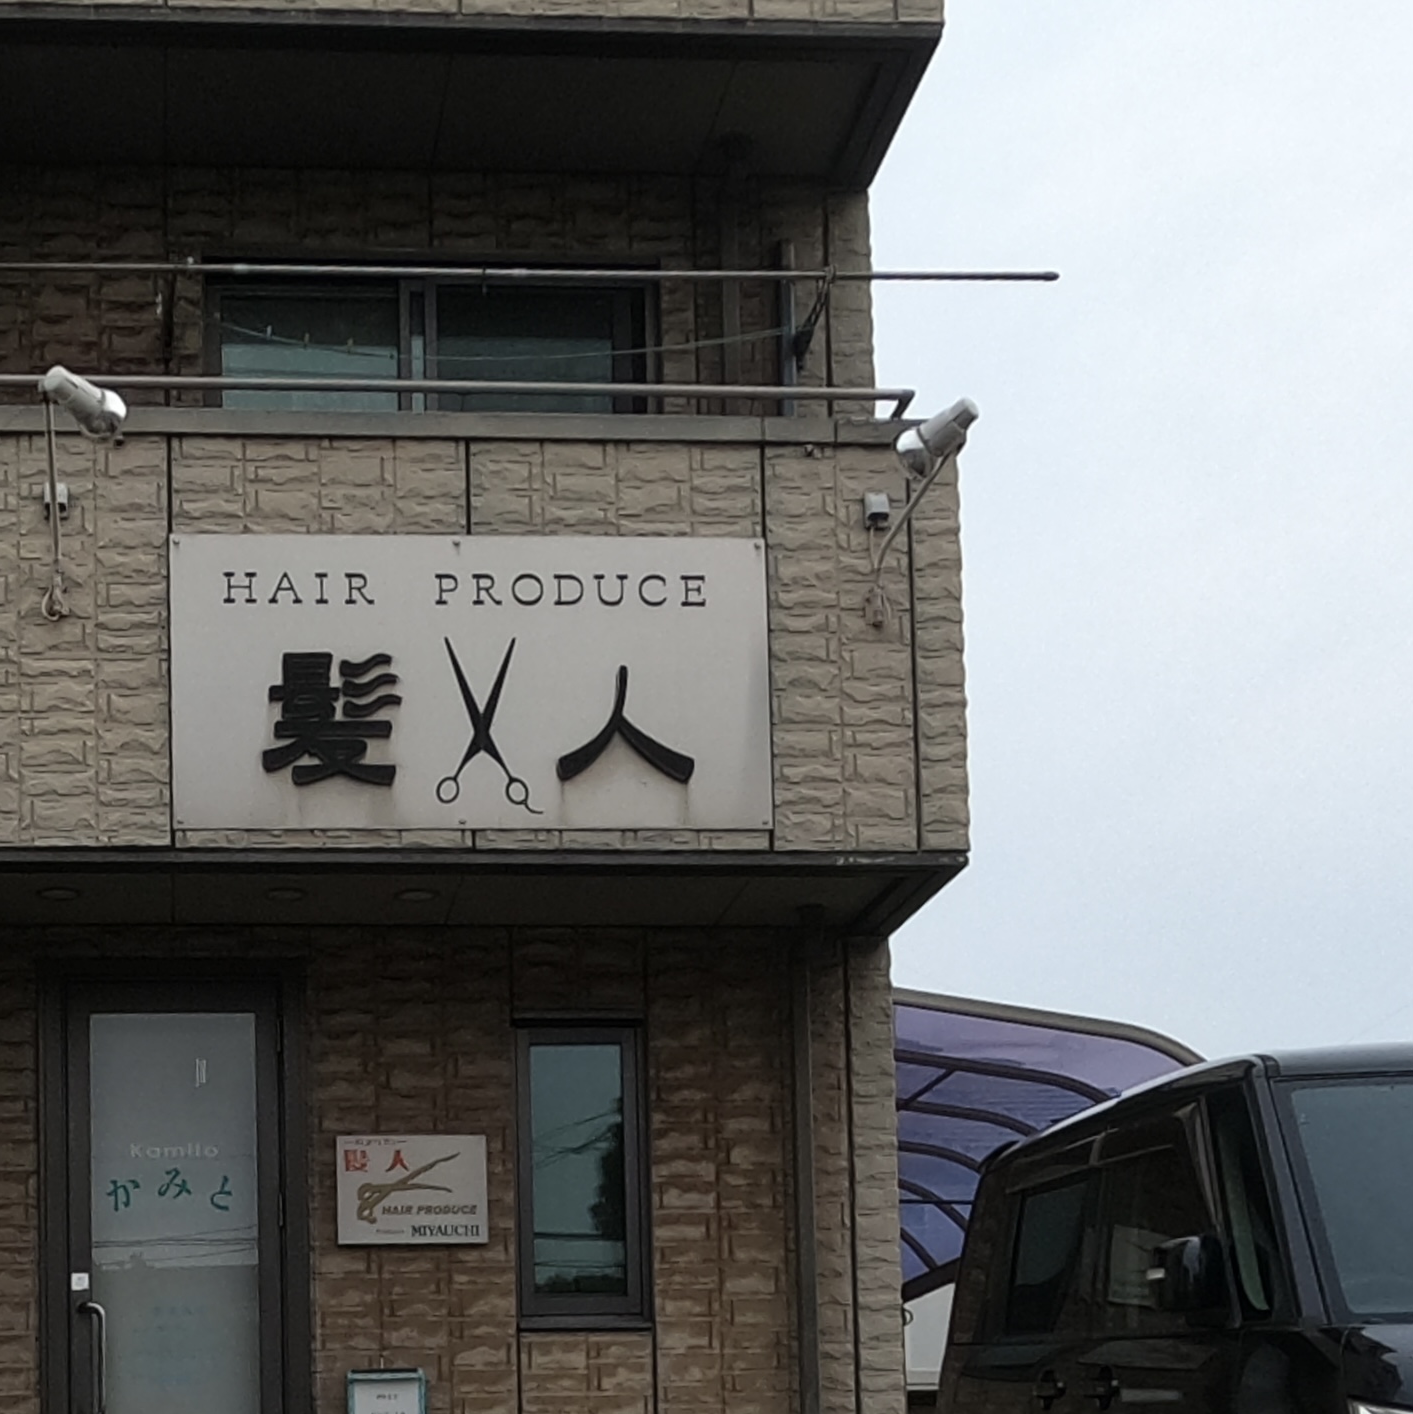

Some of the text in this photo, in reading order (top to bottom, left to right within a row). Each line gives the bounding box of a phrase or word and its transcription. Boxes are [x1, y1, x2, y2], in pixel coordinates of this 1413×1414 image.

[222, 571, 708, 608] HAIR PRODUCE
[106, 1167, 233, 1212] かみと
[382, 1204, 478, 1215] HAIR PRODUCE
[411, 1224, 480, 1237] MIYAUCHI
